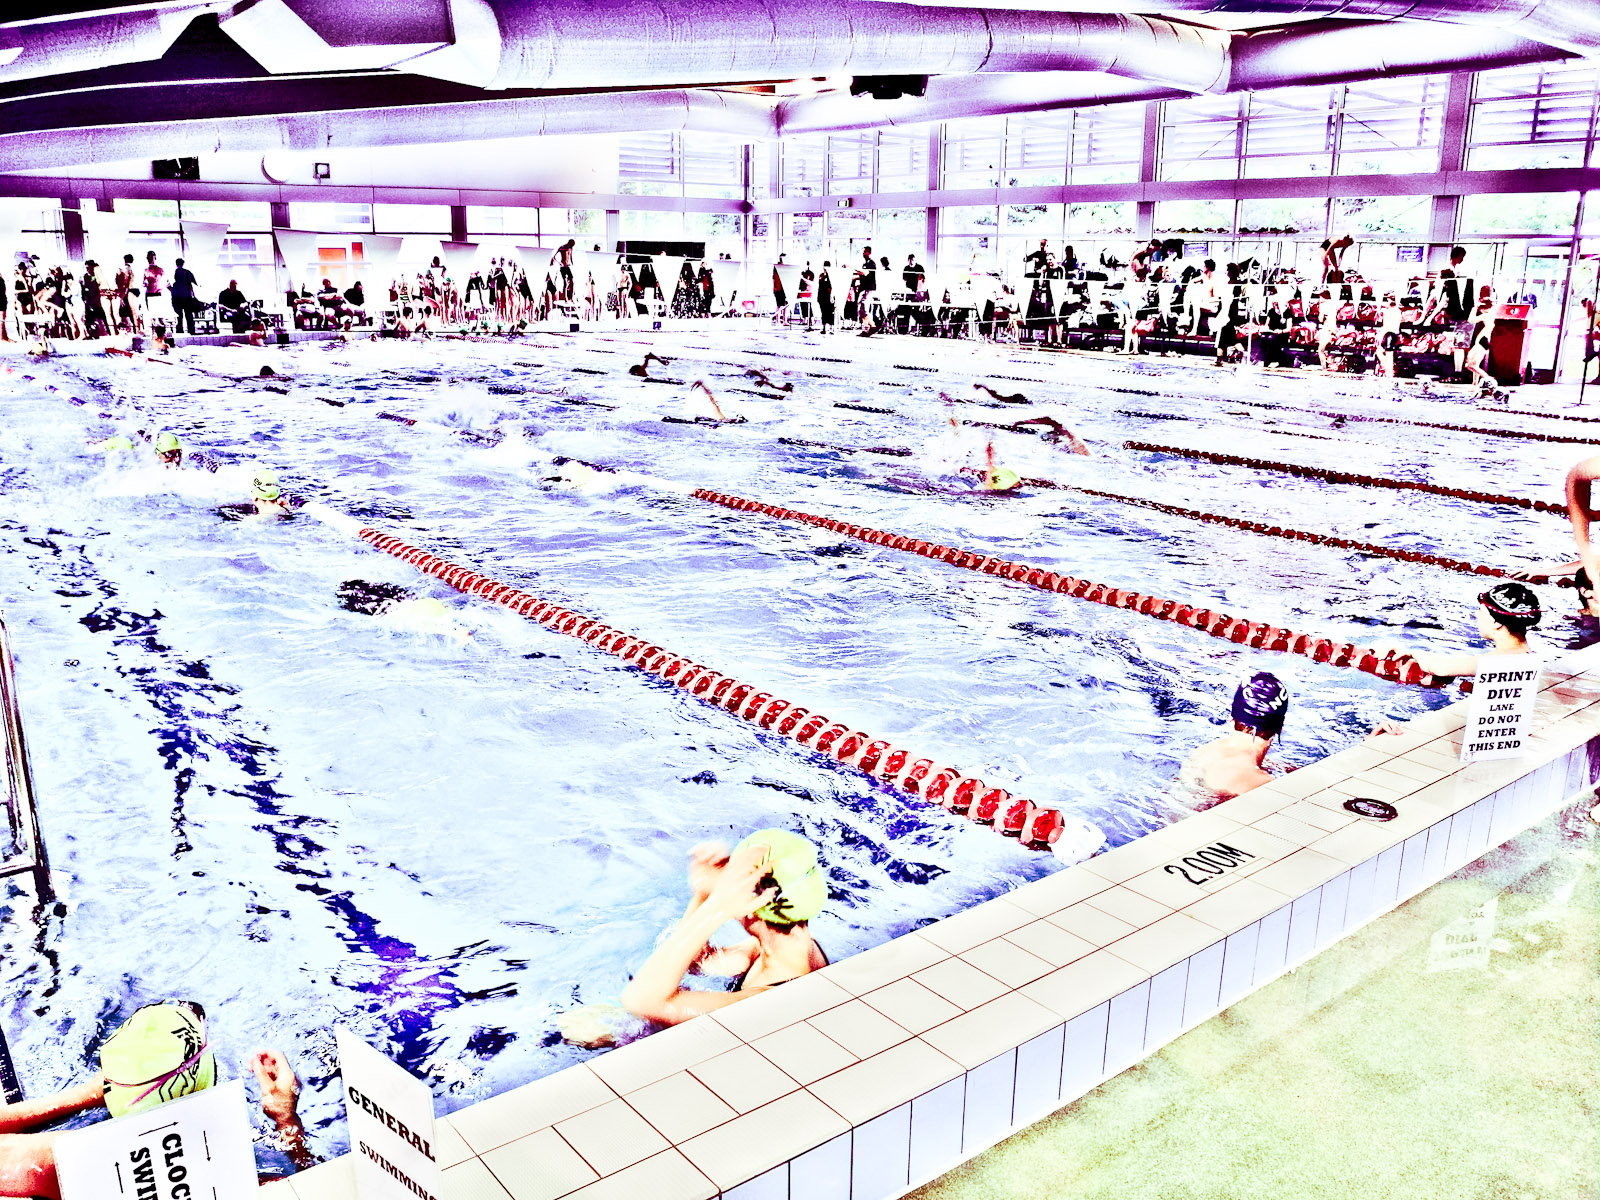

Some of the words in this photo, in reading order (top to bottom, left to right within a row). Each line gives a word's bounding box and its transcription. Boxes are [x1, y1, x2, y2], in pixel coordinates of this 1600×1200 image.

[1479, 670, 1538, 684] SPRINT/
[1487, 687, 1522, 700] DIVE
[1489, 703, 1515, 712] LANE
[1478, 716, 1495, 725] DO
[1497, 714, 1522, 724] NOT
[1478, 727, 1517, 738] ENTER
[1468, 742, 1495, 752] THIS
[1496, 740, 1521, 750] END
[1164, 842, 1256, 885] 2.00M
[348, 1085, 437, 1163] GENERAL
[162, 1133, 192, 1200] CLOC
